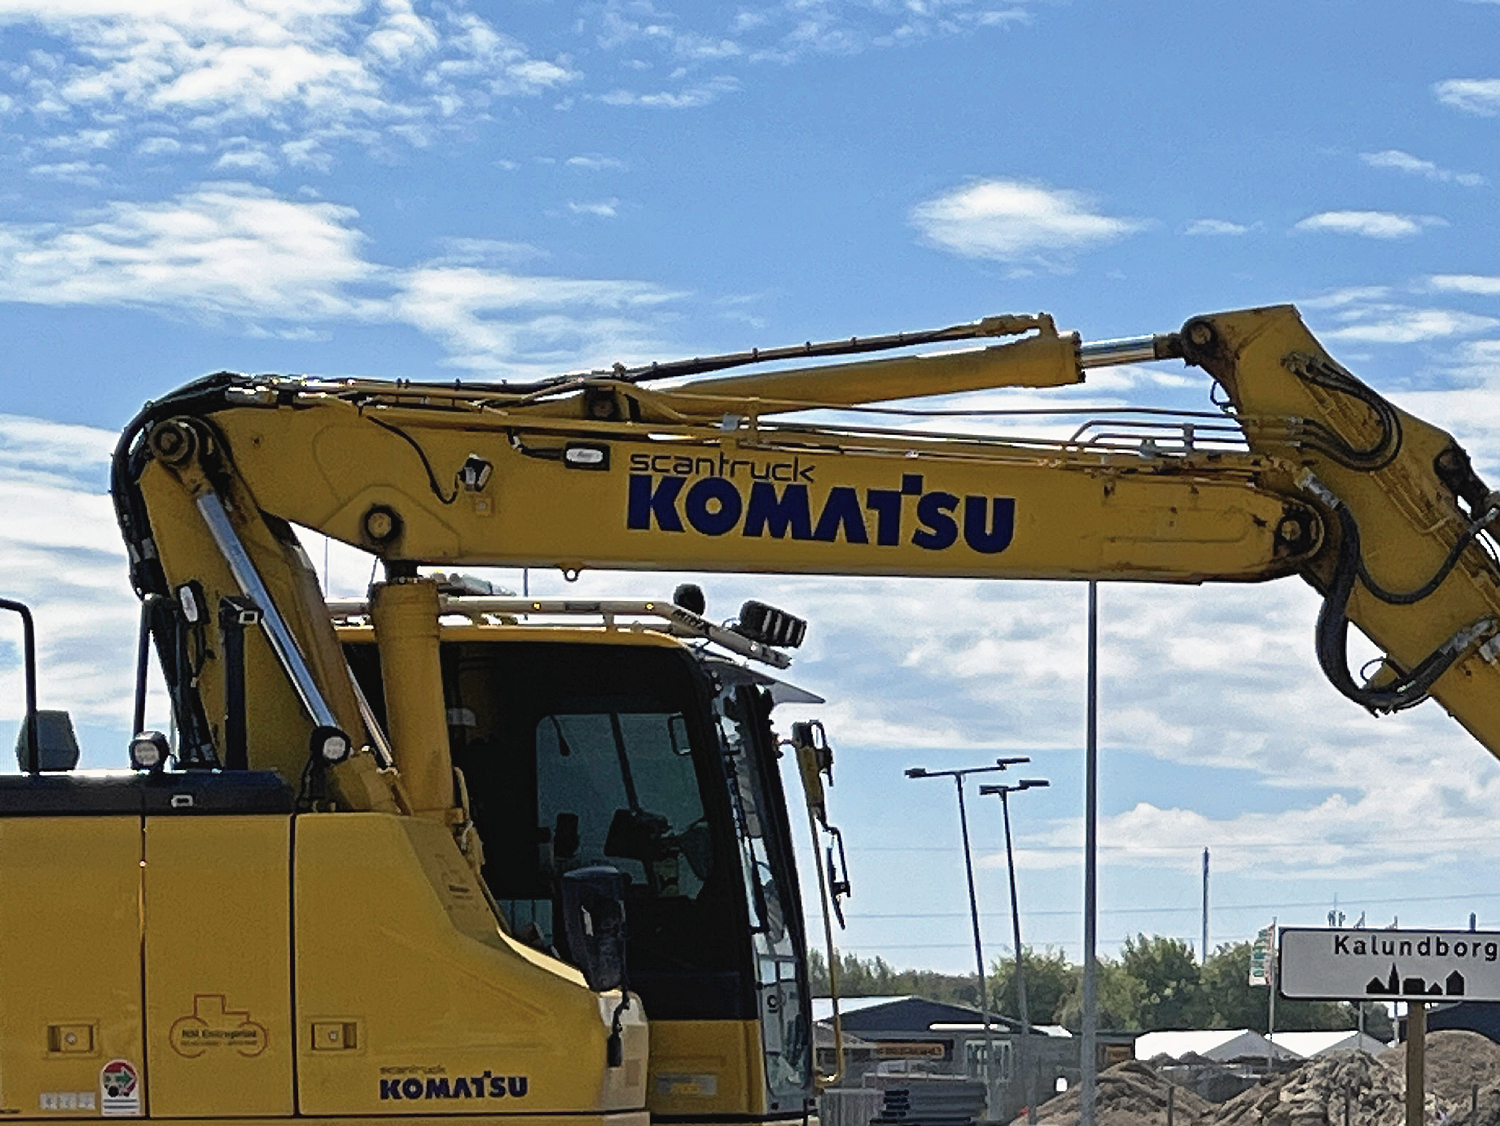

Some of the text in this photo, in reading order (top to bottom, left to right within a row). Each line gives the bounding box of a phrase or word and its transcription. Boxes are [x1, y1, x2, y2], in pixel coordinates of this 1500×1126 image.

[630, 452, 816, 483] scantruck
[627, 474, 1015, 554] KOMATSU
[1334, 935, 1498, 962] Kalundborg
[379, 1070, 528, 1100] KOMATSU
